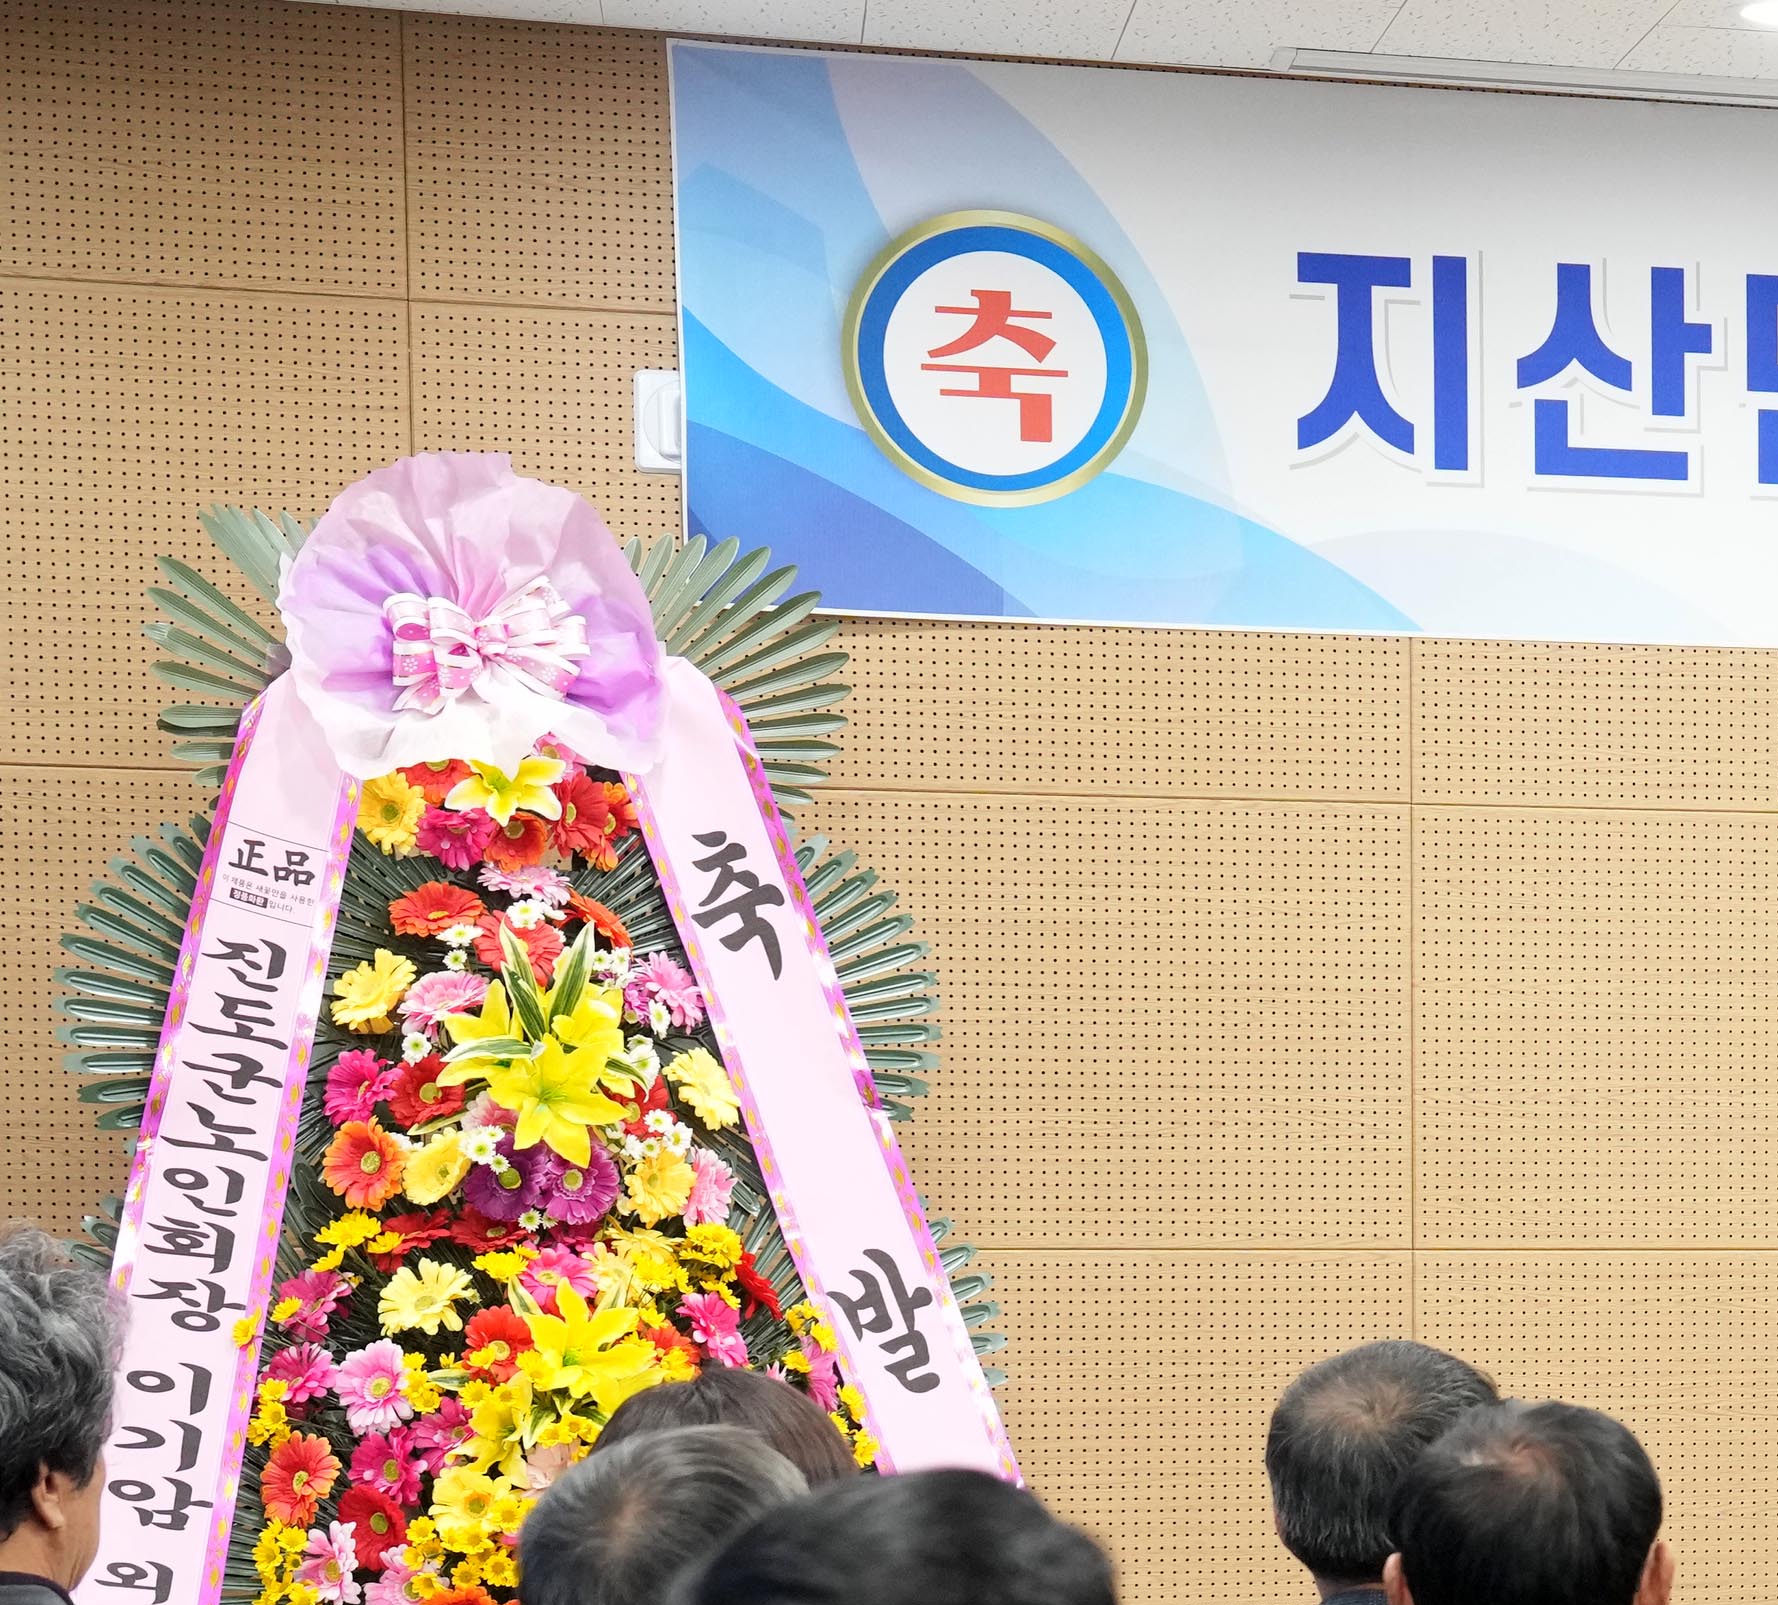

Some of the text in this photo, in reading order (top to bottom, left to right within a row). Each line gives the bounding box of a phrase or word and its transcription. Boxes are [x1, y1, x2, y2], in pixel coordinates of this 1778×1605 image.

[922, 290, 1067, 443] 축
[228, 839, 316, 887] 正品
[131, 935, 292, 1333] 진도군노인회장
[691, 830, 942, 1396] 축 발
[106, 1361, 214, 1534] 이기암
